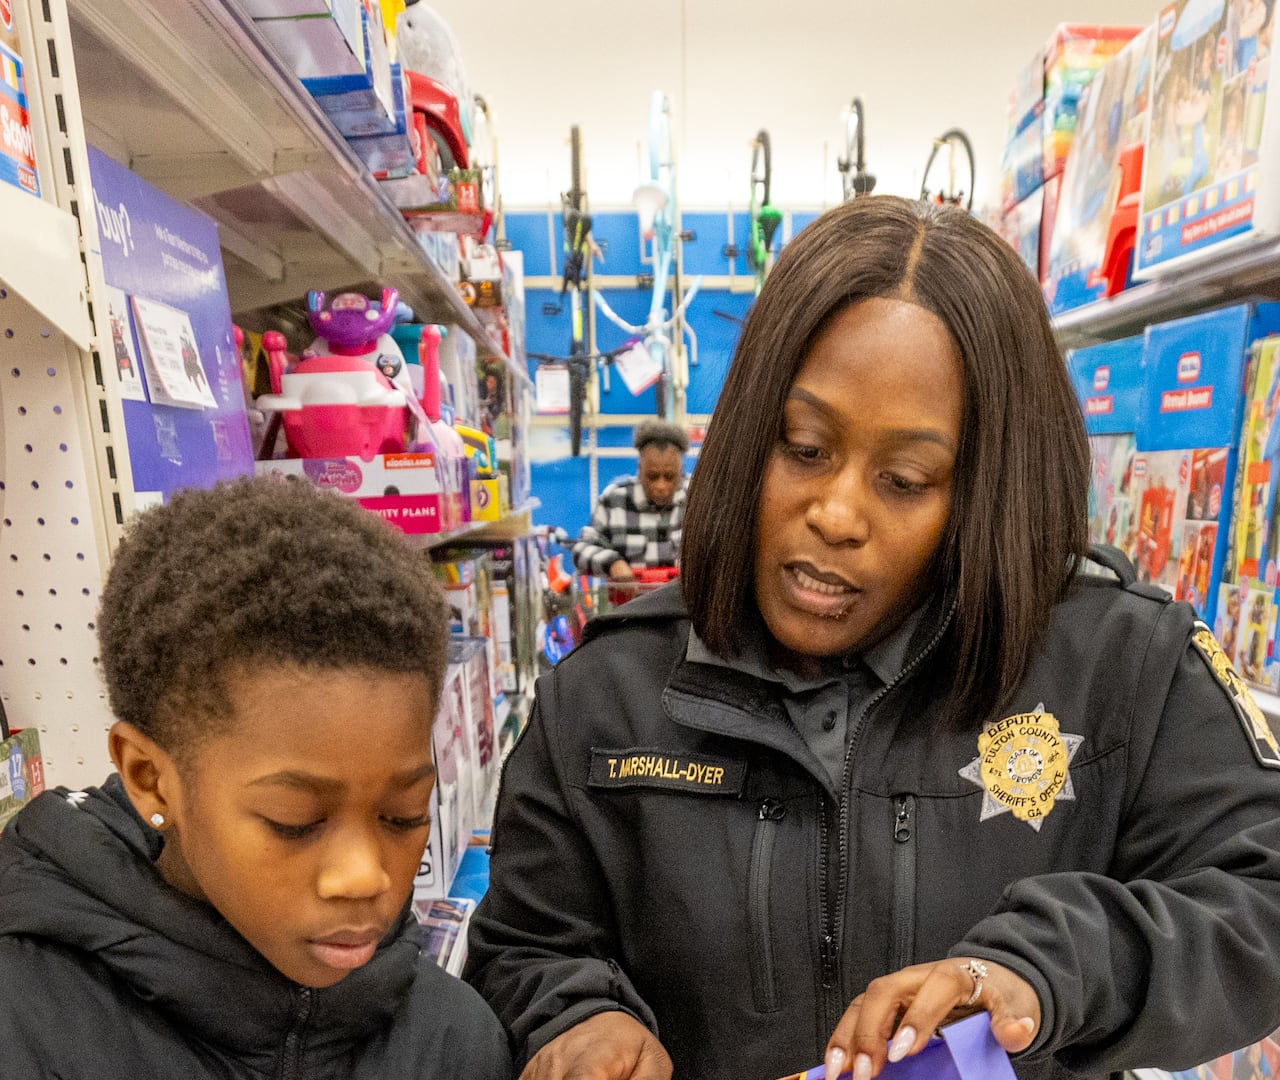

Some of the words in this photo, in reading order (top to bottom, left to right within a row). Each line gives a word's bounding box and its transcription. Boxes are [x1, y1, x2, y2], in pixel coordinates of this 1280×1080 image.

[403, 506, 437, 517] PLANE
[987, 714, 1042, 738] DEPUTY
[985, 730, 1016, 764] FULTON
[1019, 726, 1060, 748] COUNTY
[1008, 749, 1027, 765] STATE
[1028, 748, 1039, 757] OF
[607, 758, 617, 779] T.
[618, 756, 724, 785] MARSHALL-DYER
[1011, 768, 1043, 784] GEORGIA
[989, 783, 1037, 807] SHERIFF'S
[1039, 770, 1065, 802] OFFICE
[1027, 807, 1043, 818] GA
